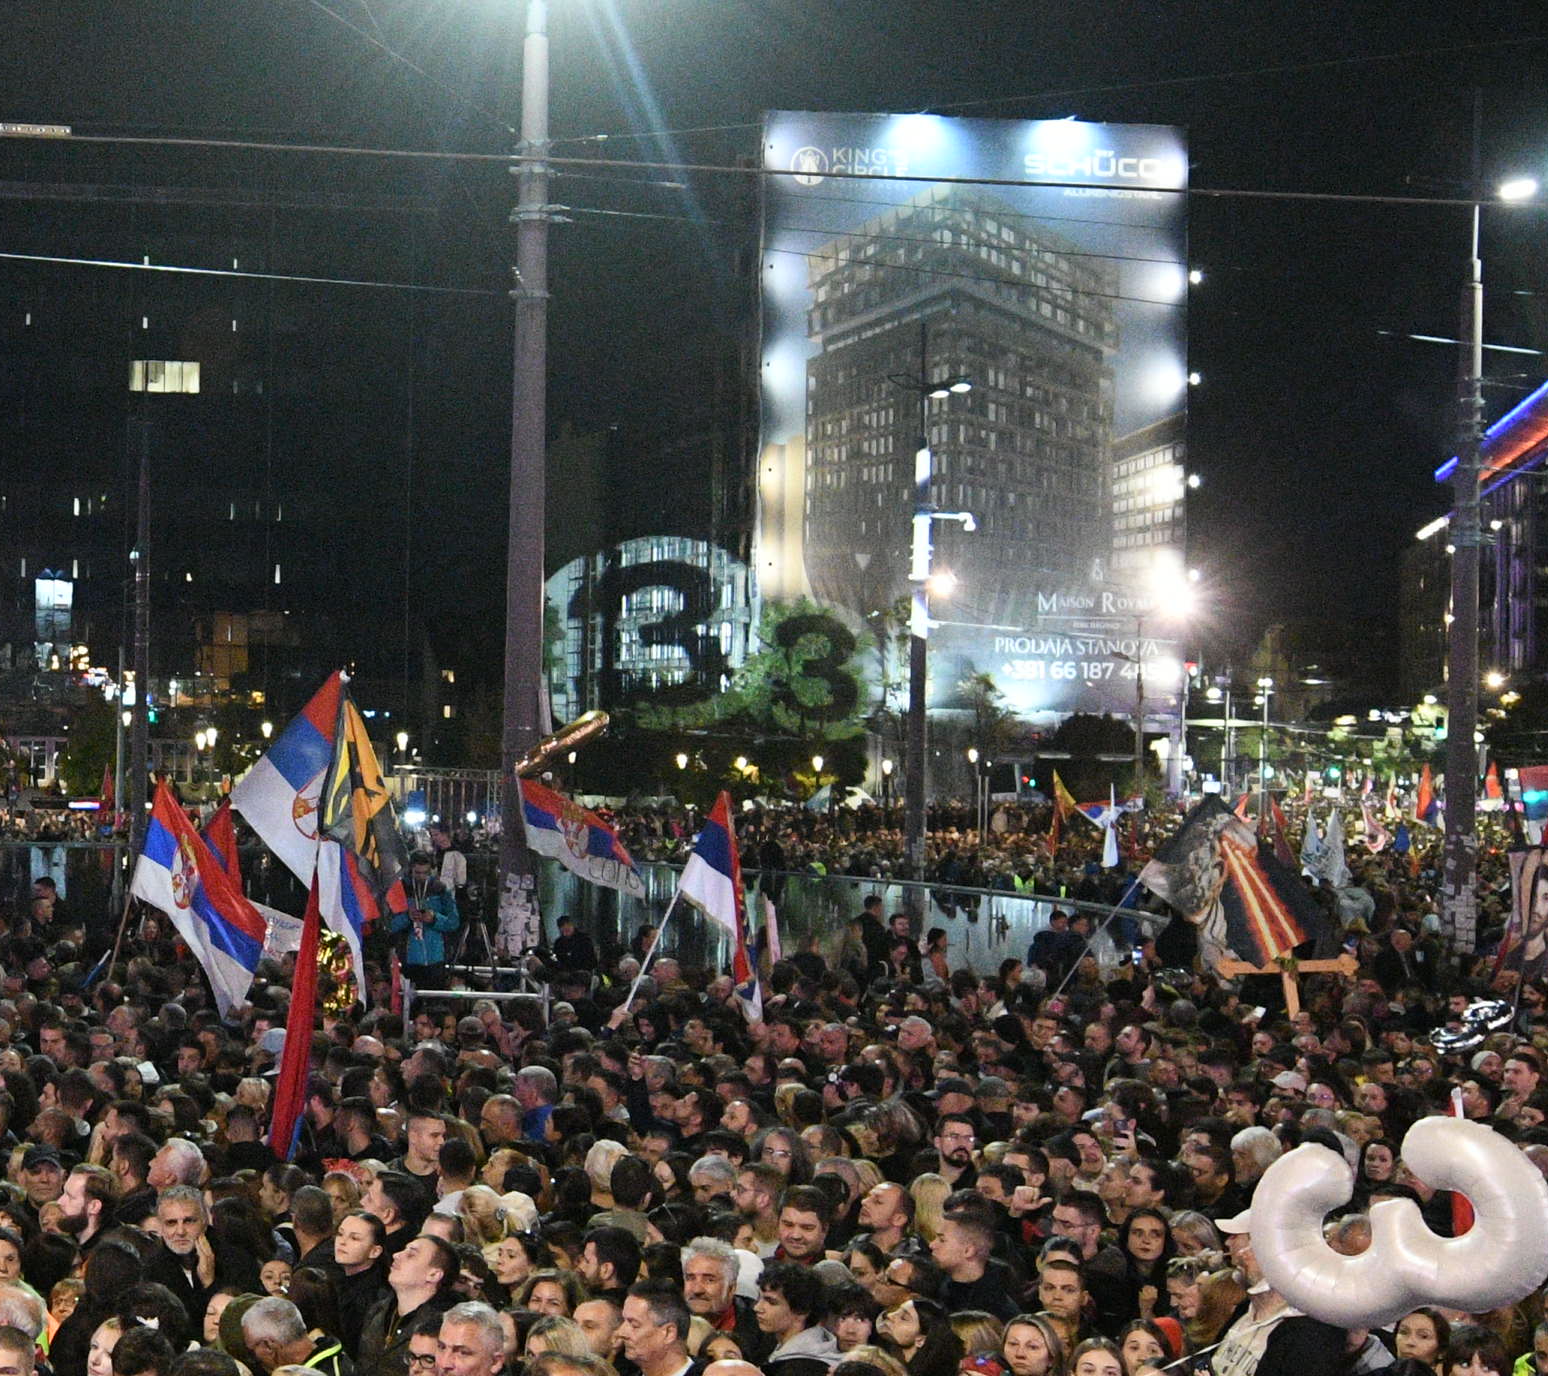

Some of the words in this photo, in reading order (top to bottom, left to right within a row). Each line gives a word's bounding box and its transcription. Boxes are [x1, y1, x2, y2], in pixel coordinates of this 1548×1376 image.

[994, 636, 1072, 657] PRODAJA
[1075, 639, 1159, 657] STANOVA
[1049, 660, 1077, 680] 66
[1081, 661, 1115, 680] 187
